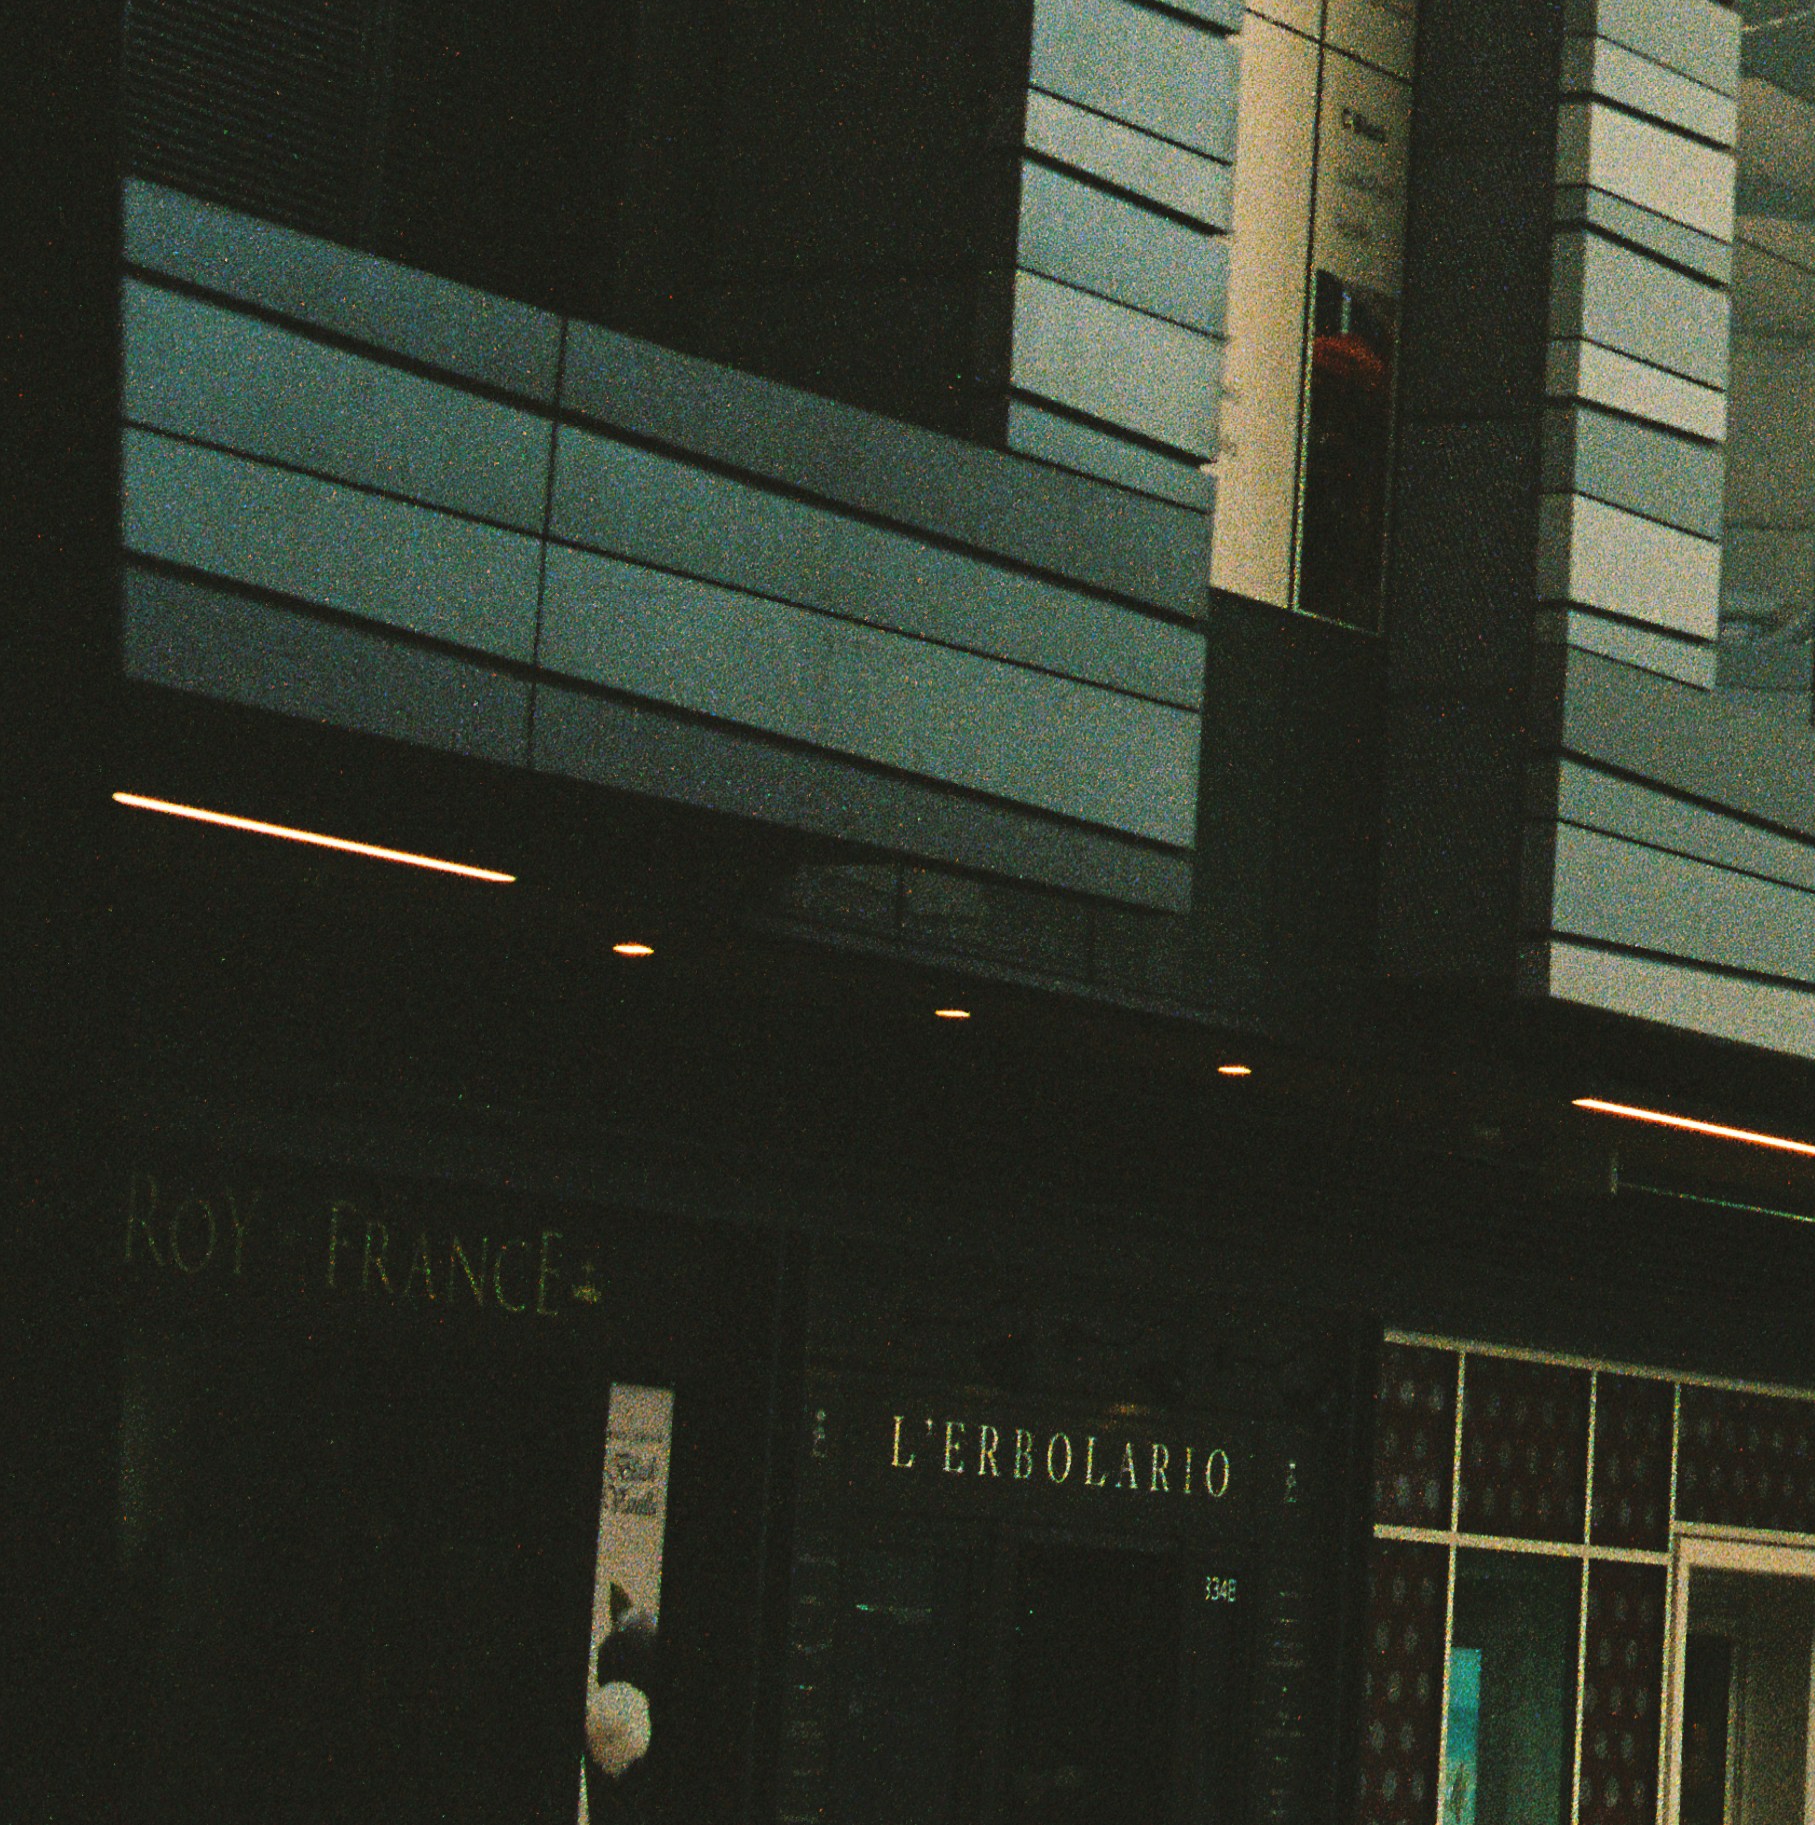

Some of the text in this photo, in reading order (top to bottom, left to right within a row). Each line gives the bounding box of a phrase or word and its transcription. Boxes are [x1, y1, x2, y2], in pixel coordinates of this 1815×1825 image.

[124, 1171, 564, 1317] ROY FRANCE
[890, 1414, 1231, 1499] L'ERBOLARIO
